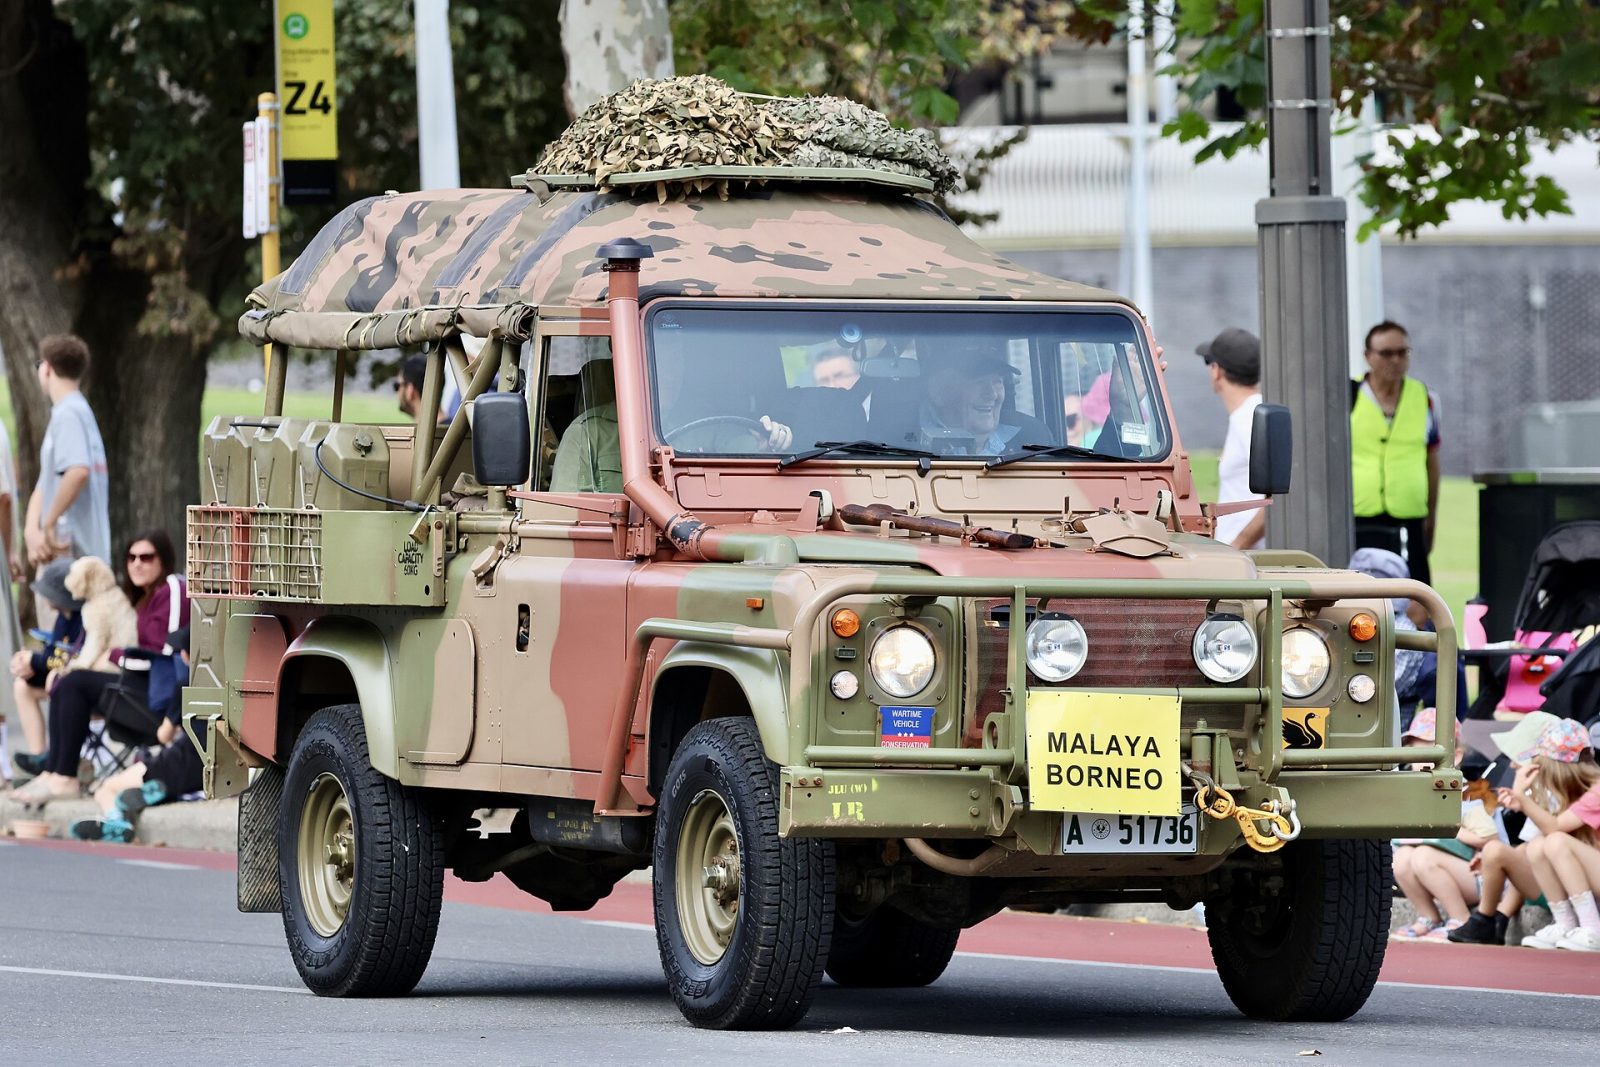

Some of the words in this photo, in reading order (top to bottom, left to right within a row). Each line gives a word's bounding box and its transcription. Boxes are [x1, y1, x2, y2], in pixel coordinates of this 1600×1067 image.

[284, 81, 331, 115] Z4
[403, 541, 419, 552] LOAD
[397, 552, 424, 564] CAPACITY
[892, 709, 923, 718] WARTIME
[893, 719, 920, 728] VEHICLE
[881, 741, 929, 749] CONSERVATION
[1047, 732, 1161, 758] MALAYA
[1046, 764, 1163, 790] BORNEO
[828, 784, 847, 795] JLU
[850, 783, 868, 795] (W)
[1066, 815, 1084, 845] A
[1118, 815, 1194, 845] 51736
